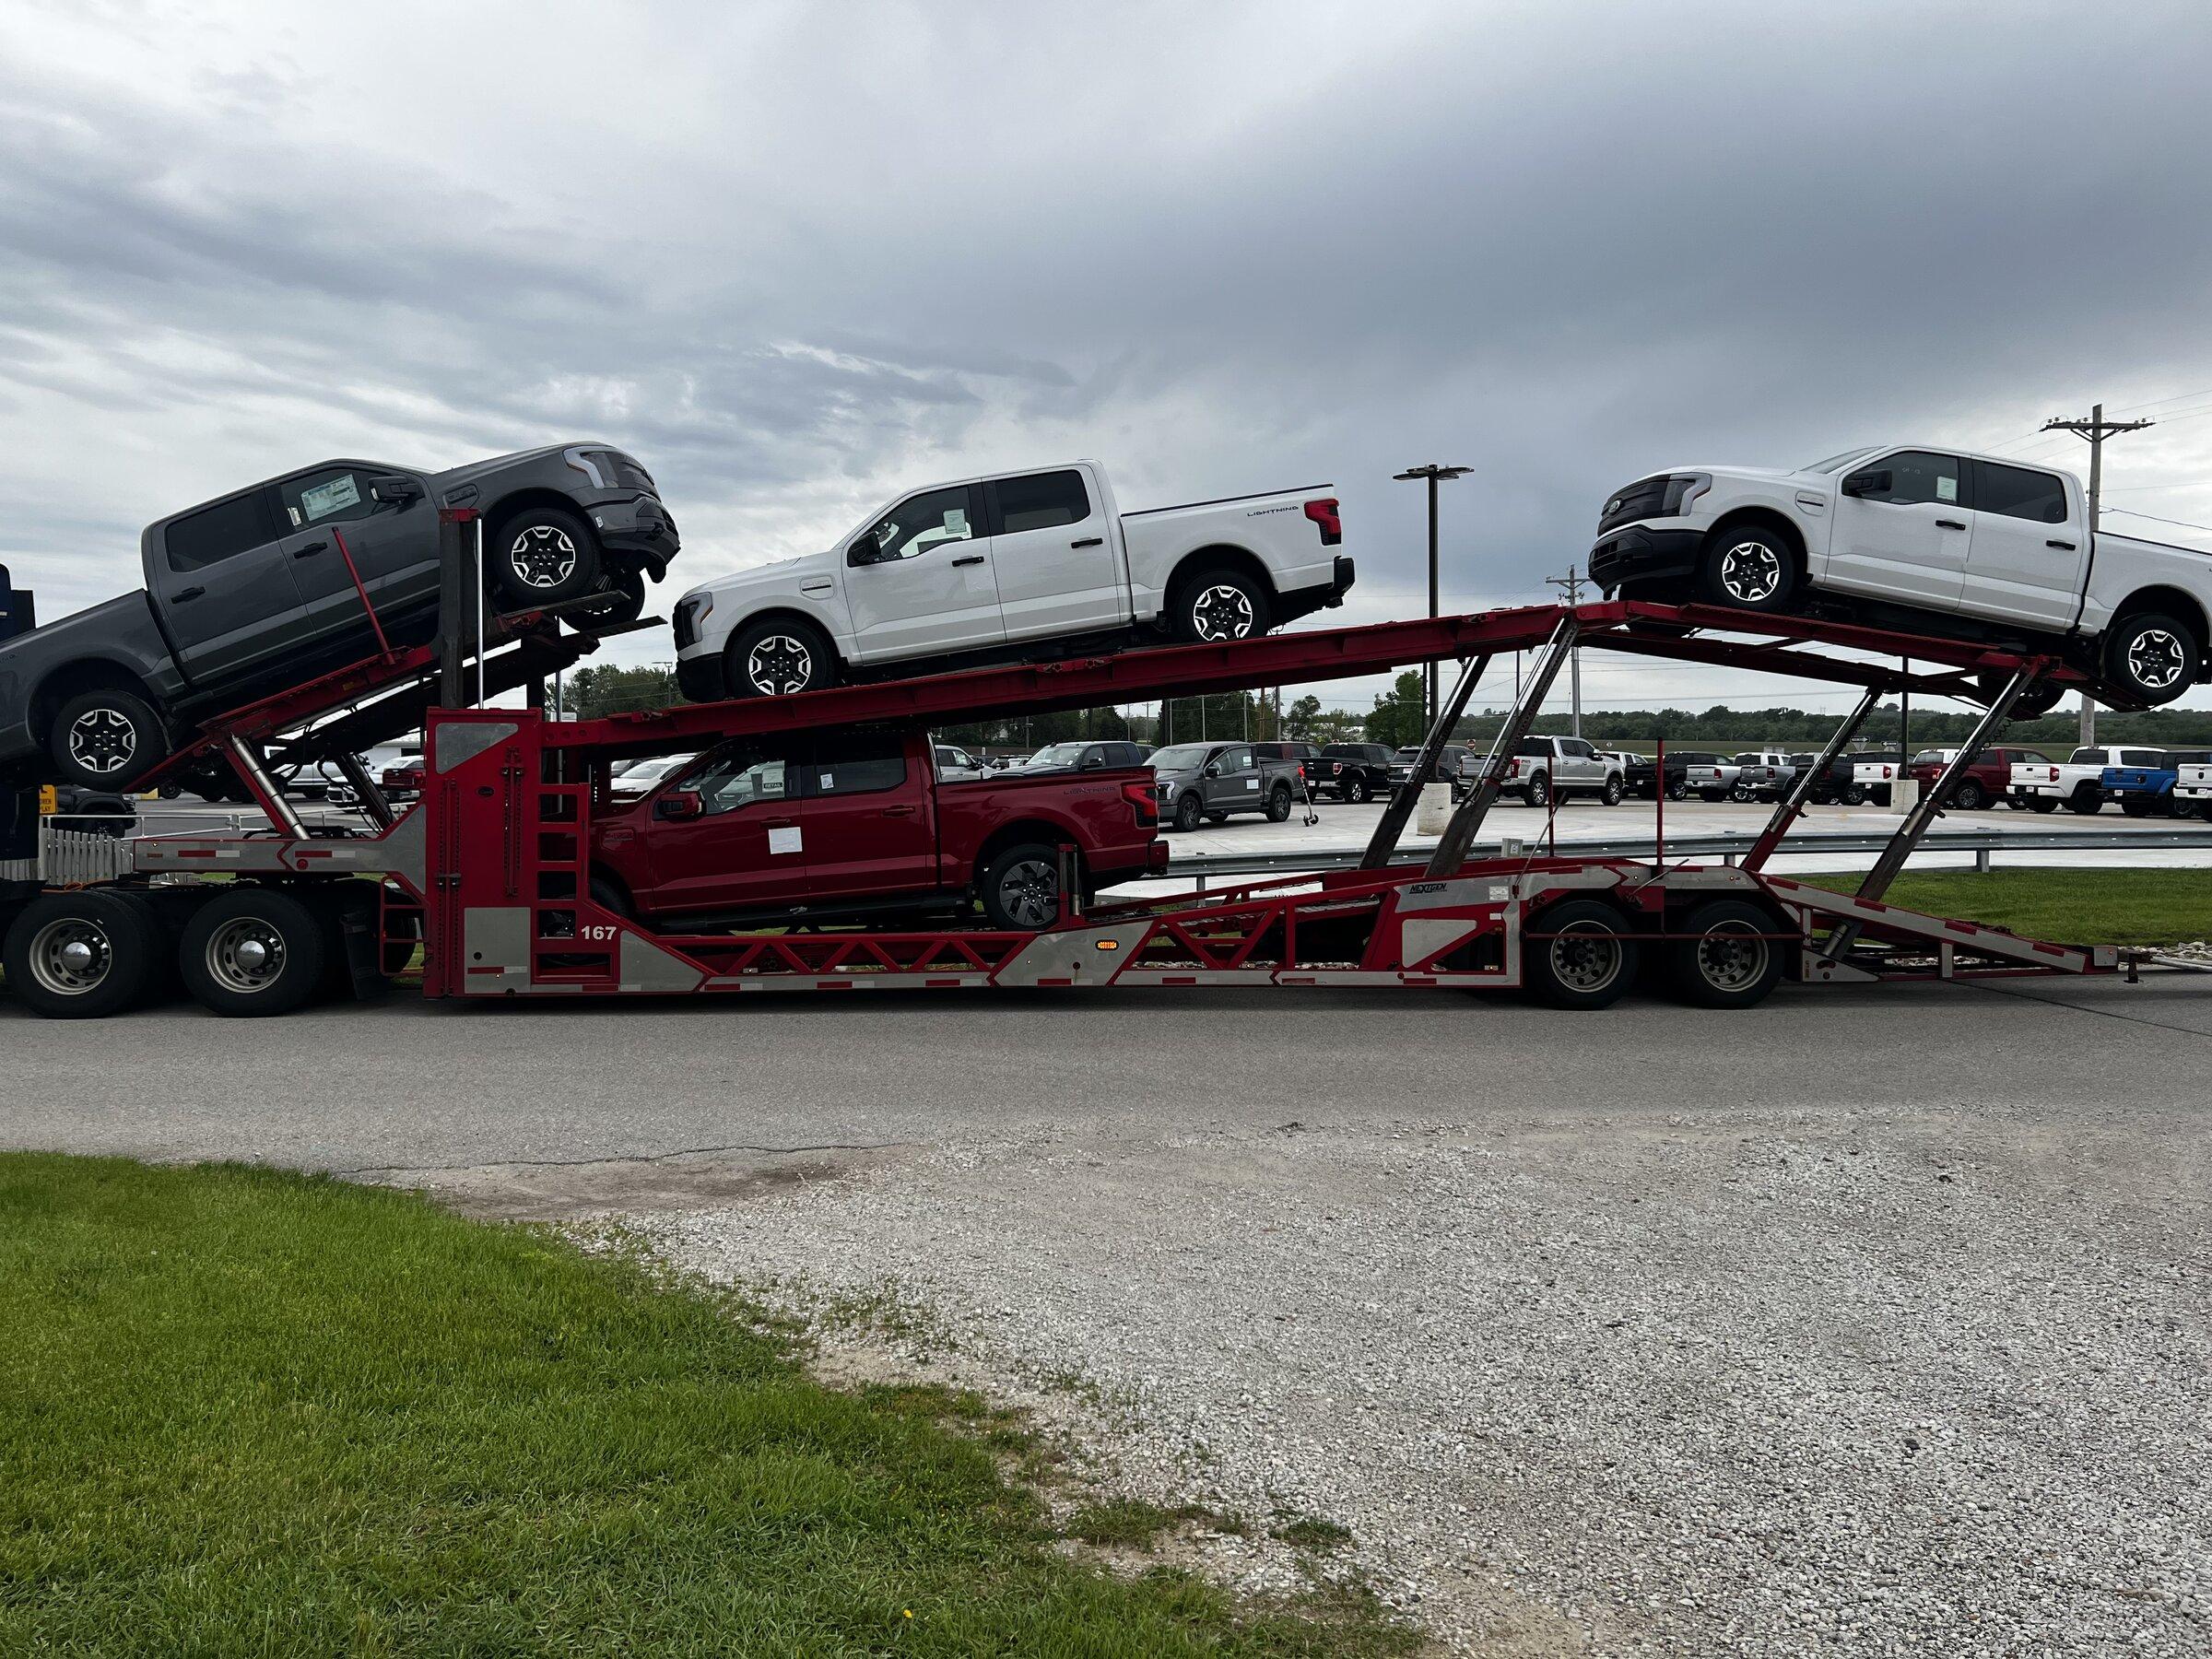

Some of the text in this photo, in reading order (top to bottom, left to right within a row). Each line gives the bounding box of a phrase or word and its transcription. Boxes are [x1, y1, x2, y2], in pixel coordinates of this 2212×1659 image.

[1247, 505, 1299, 517] LIGHTNING
[1409, 883, 1447, 895] NEXTGEN
[582, 925, 617, 940] 167
